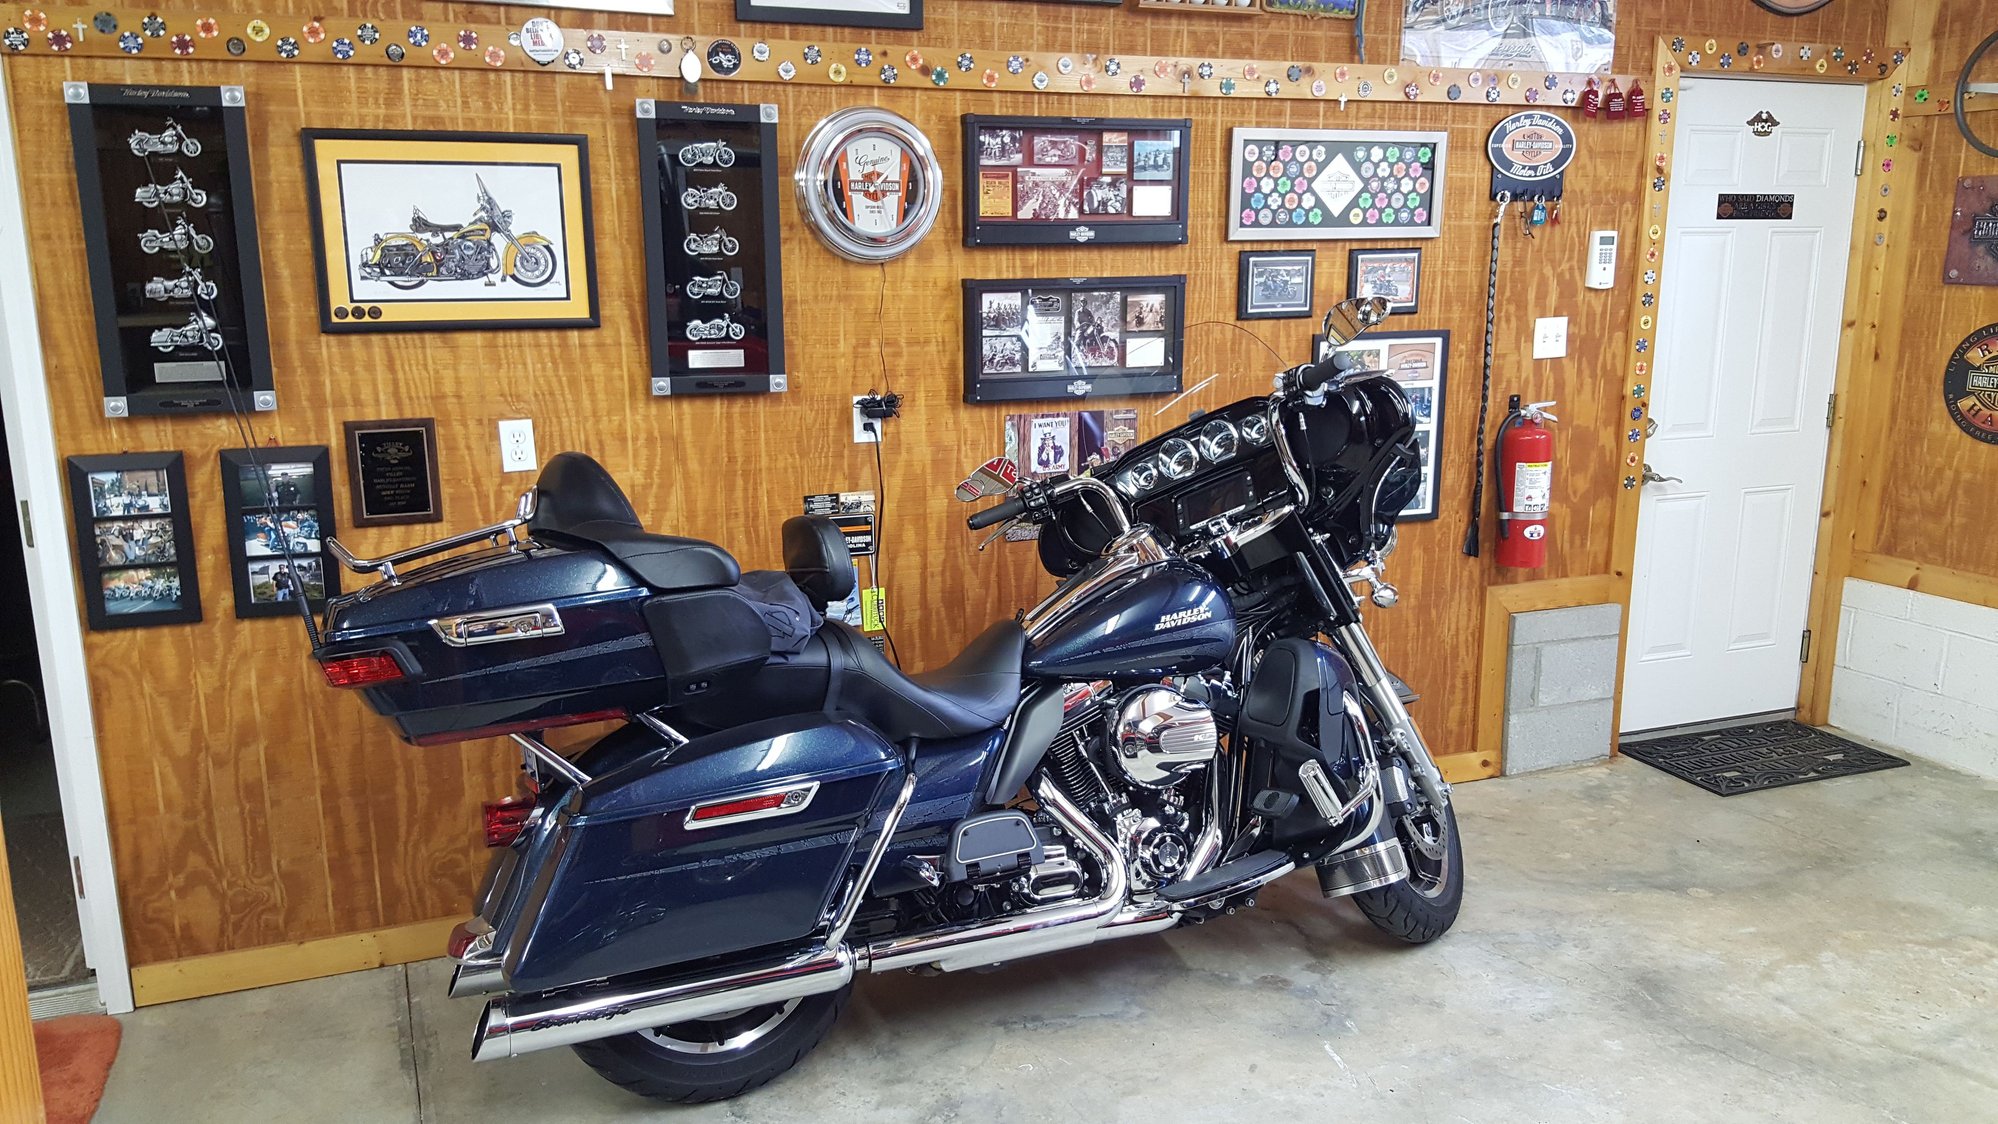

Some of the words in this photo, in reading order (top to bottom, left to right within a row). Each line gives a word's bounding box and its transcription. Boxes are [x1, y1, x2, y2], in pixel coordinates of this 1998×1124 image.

[1503, 114, 1565, 135] Harley-Davidson
[1754, 122, 1772, 132] HOG
[1515, 141, 1554, 149] HARLEY-DAVIDSON
[1509, 162, 1535, 177] Motor
[1536, 162, 1555, 177] Oils
[1756, 194, 1794, 203] DIAMONDS
[1038, 421, 1054, 429] WANT
[1160, 606, 1210, 623] HARLEY-
[1153, 611, 1212, 631] DAVIDSON
